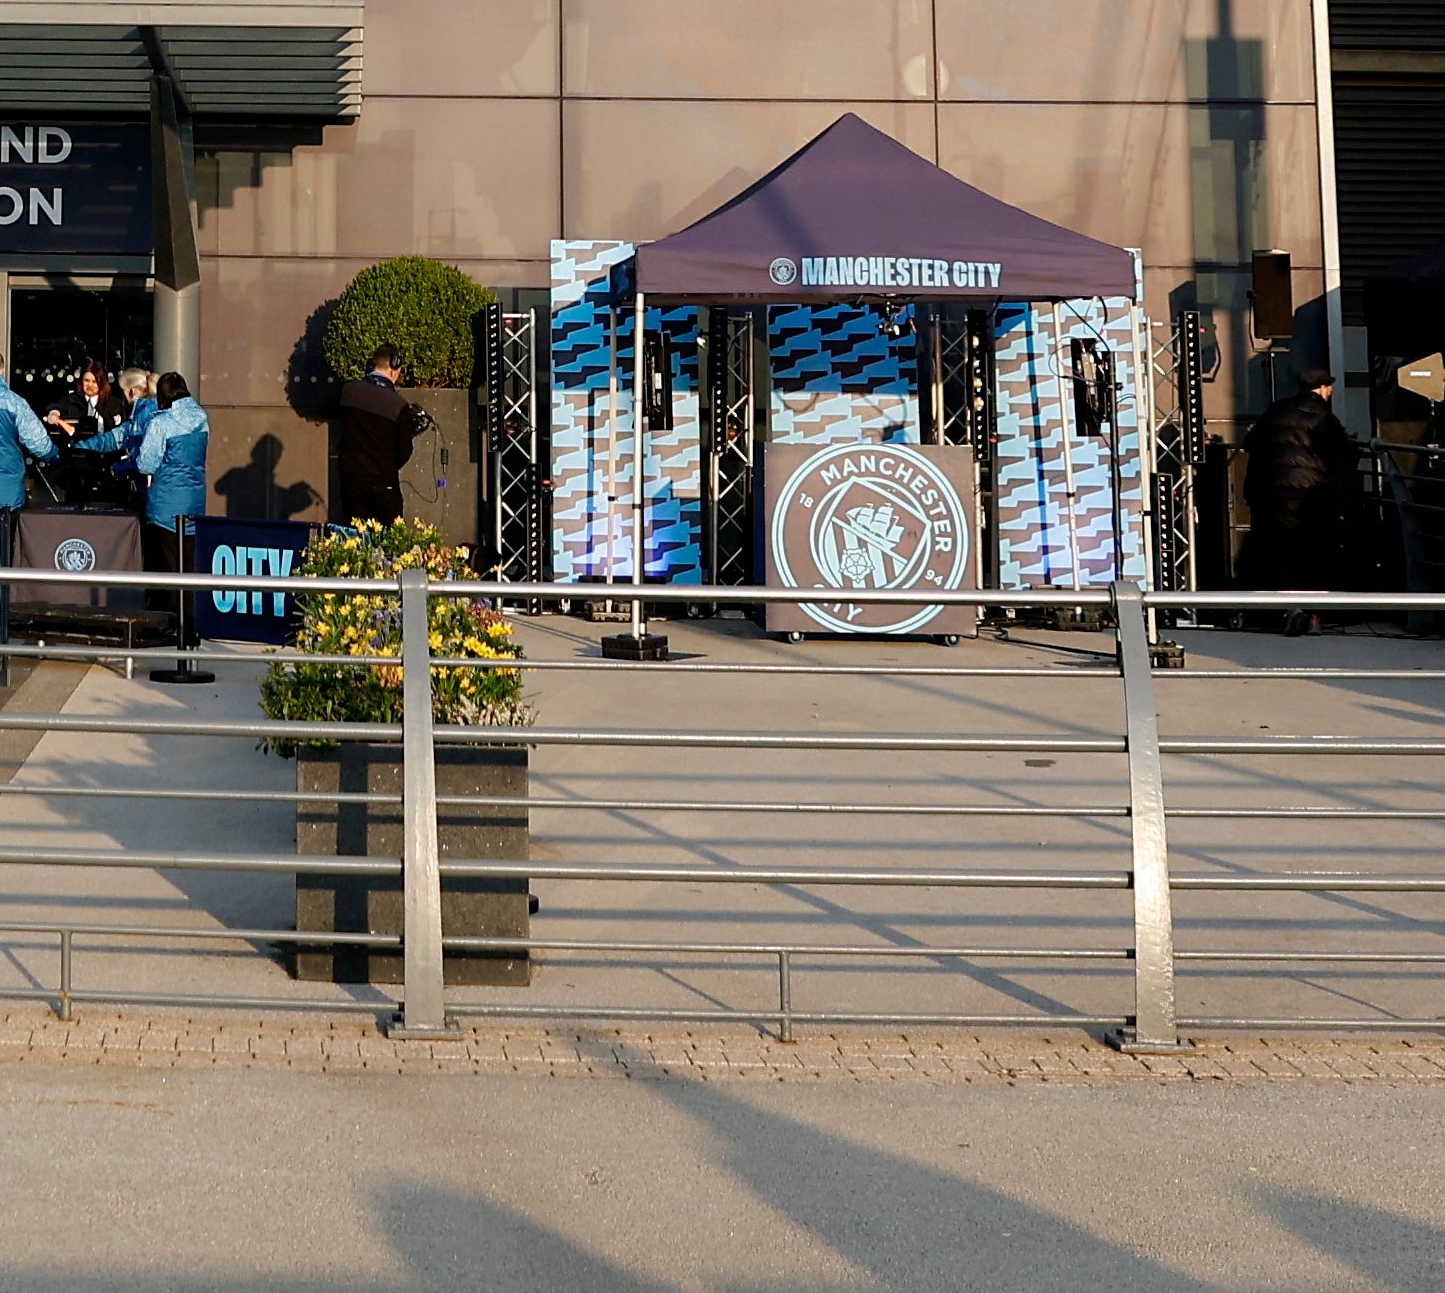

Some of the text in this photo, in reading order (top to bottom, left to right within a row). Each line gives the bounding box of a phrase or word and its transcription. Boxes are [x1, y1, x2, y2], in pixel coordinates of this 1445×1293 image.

[802, 257, 1001, 288] MANCHESTER CITY
[799, 493, 944, 586] 18 94
[819, 455, 952, 552] MANCHESTER
[212, 544, 293, 617] CITY
